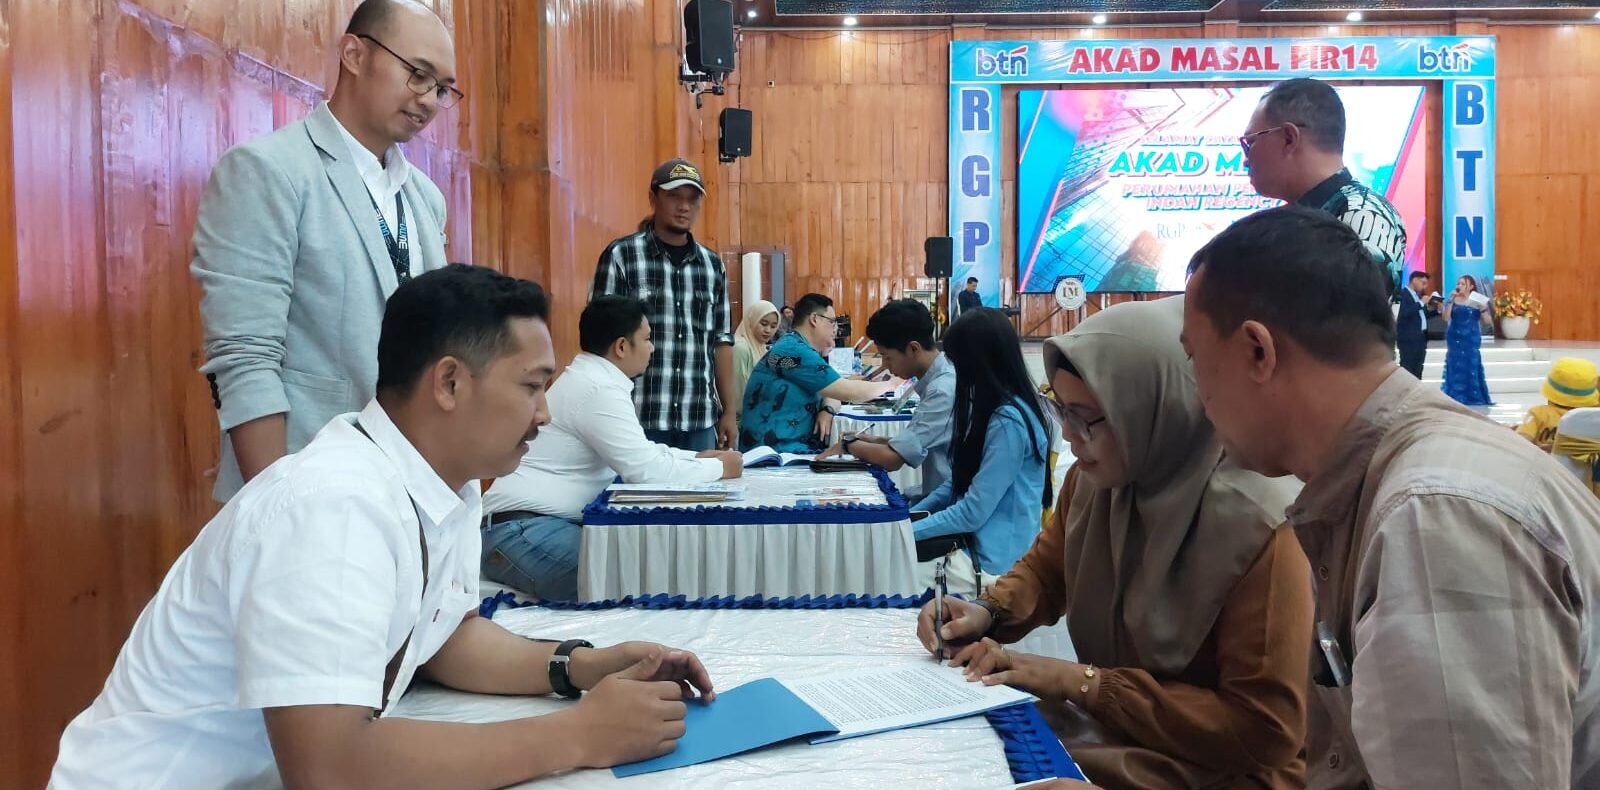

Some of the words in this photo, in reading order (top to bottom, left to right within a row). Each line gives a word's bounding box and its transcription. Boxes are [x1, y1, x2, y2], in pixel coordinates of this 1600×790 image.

[977, 46, 1028, 75] btn
[1068, 47, 1161, 73] AKAD
[1170, 46, 1280, 72] MASAL
[1289, 45, 1377, 71] PIR14
[1418, 44, 1471, 71] btn
[961, 89, 990, 263] RGP
[1108, 150, 1209, 177] AKAD
[1455, 84, 1485, 258] BTN
[1121, 182, 1231, 198] PERUMAHAN
[1146, 196, 1203, 211] INDAH
